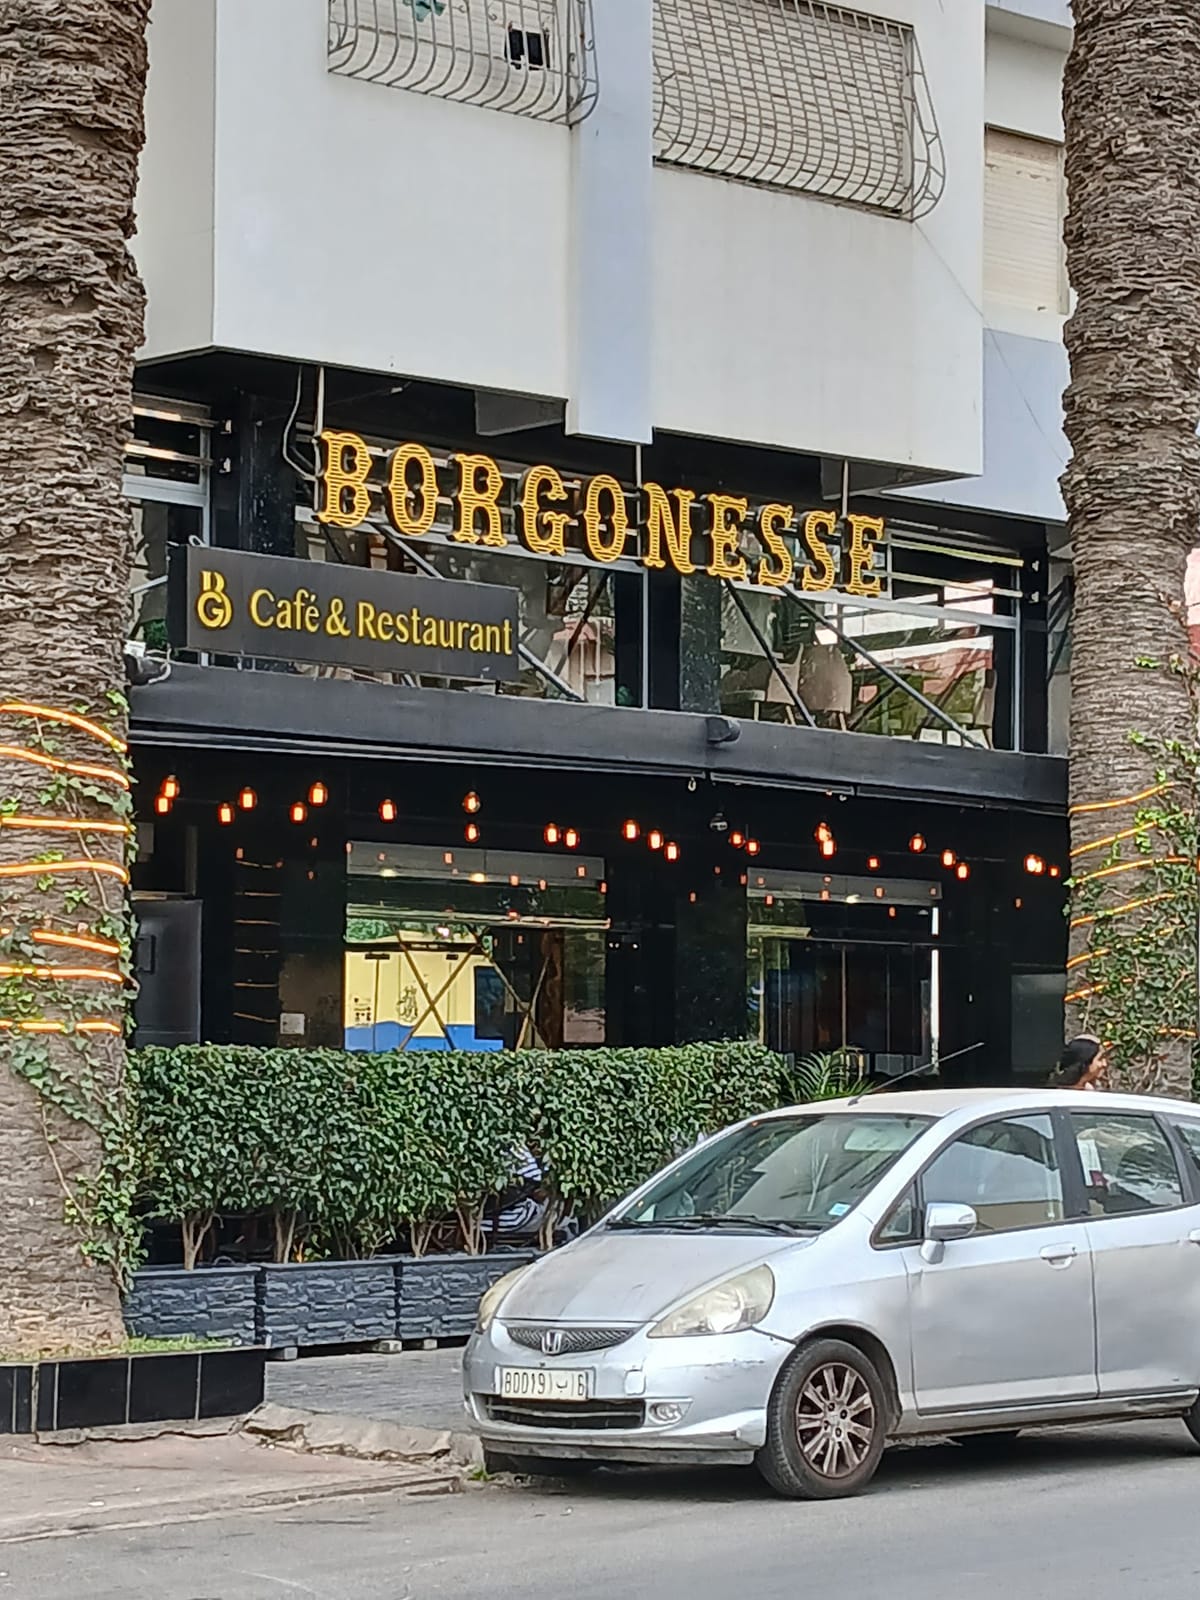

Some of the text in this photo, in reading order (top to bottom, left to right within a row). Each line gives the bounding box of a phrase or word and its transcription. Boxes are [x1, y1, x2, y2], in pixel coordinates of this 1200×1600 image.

[318, 430, 885, 597] BORGONESSE
[250, 588, 513, 655] Café & Restaurant
[504, 1371, 546, 1394] 80019
[577, 1373, 585, 1396] 6
